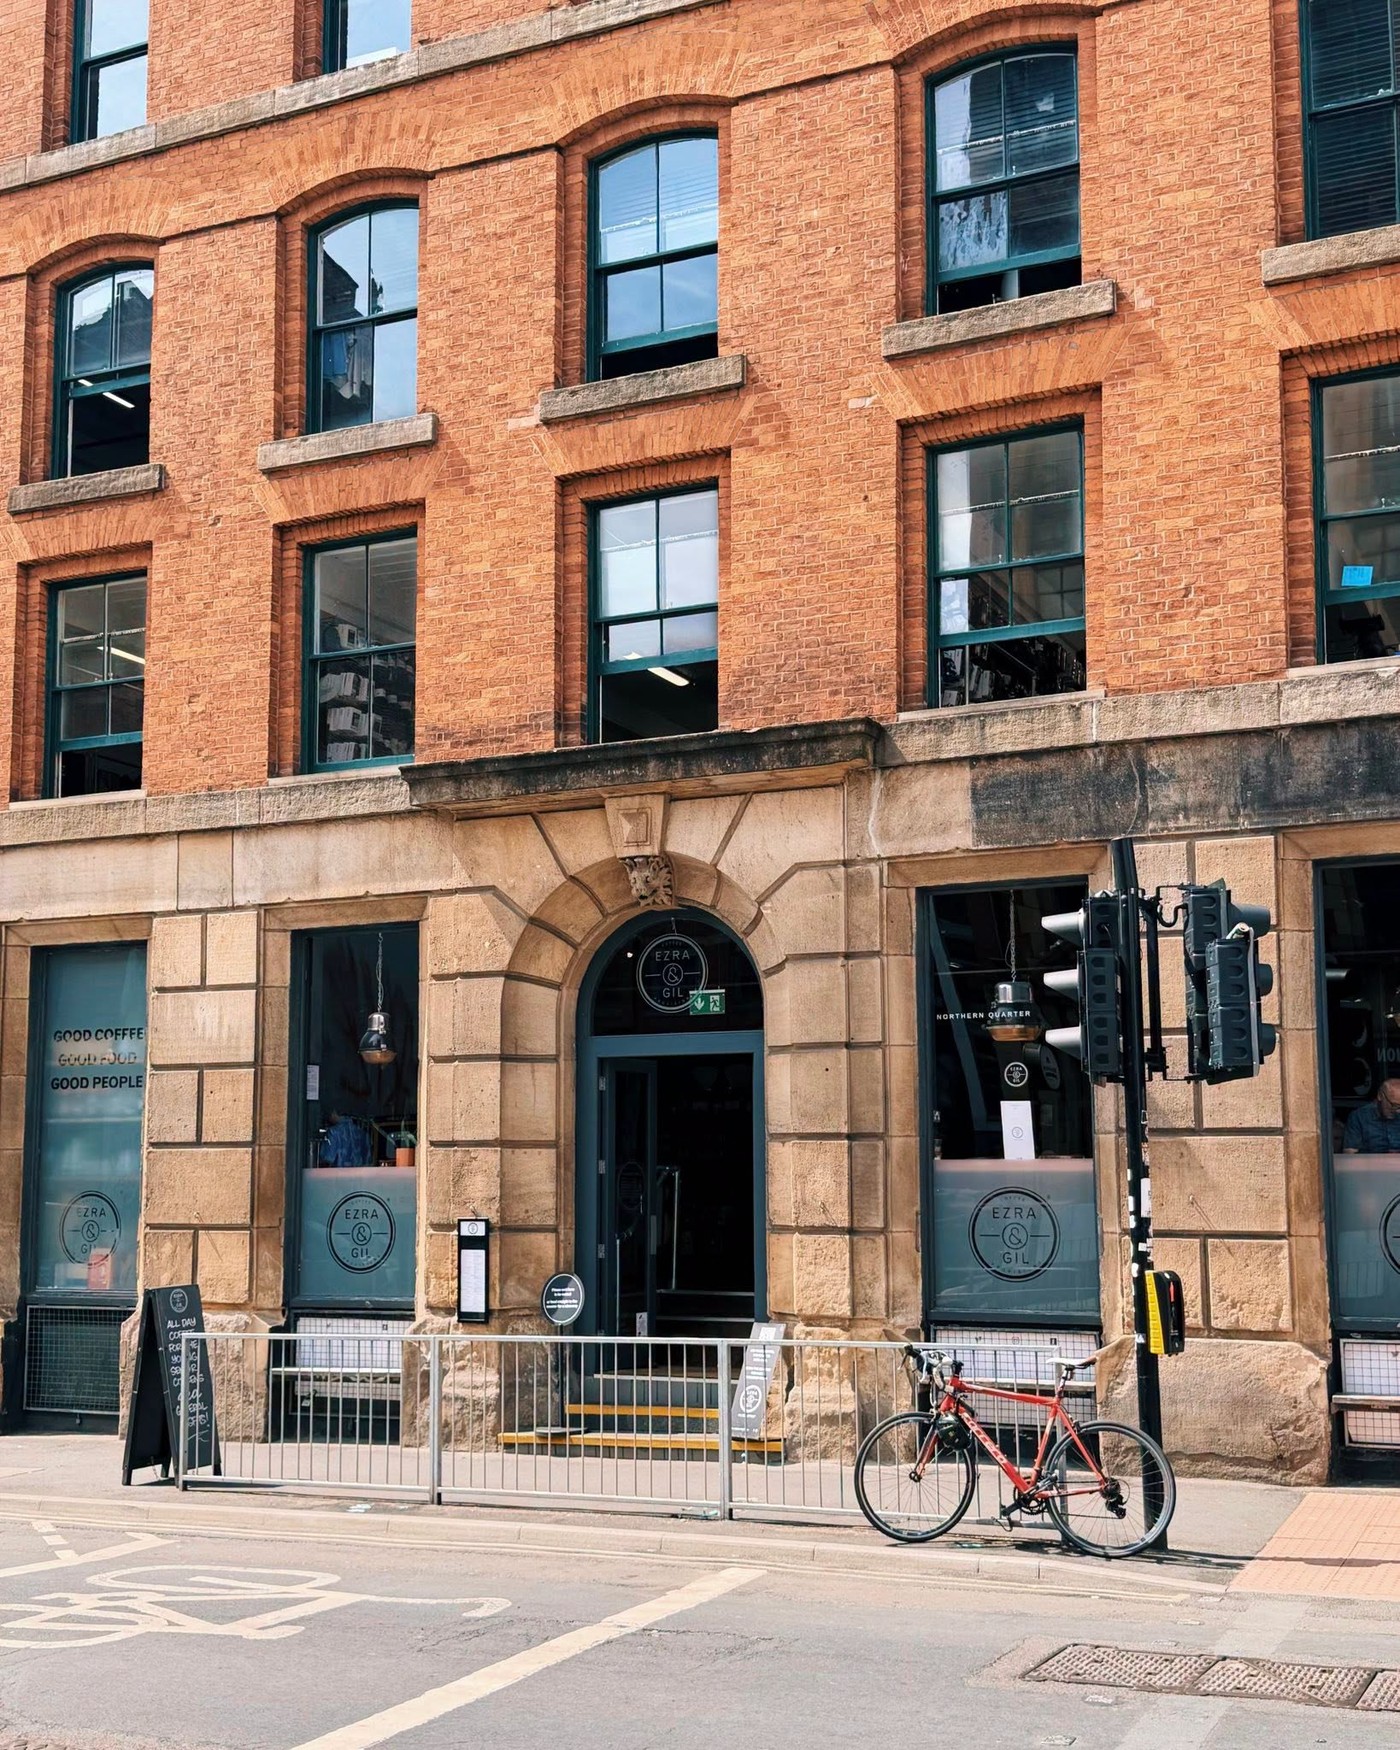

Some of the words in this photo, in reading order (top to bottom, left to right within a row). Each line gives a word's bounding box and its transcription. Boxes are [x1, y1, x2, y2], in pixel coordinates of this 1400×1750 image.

[655, 950, 690, 961] EZRA
[667, 966, 679, 982] &
[662, 988, 684, 998] GIL
[936, 1012, 985, 1020] NORTHERN
[988, 1010, 1031, 1019] QUARTER
[53, 1030, 92, 1043] GOOD
[94, 1027, 144, 1041] COFFEE
[58, 1052, 97, 1066] GOOD
[51, 1076, 89, 1089] GOOD
[92, 1075, 143, 1088] PEOPLE
[77, 1207, 106, 1217] EZRA
[345, 1208, 379, 1220] EZRA
[992, 1206, 1037, 1219] EZRA
[86, 1223, 95, 1239] &
[356, 1225, 367, 1242] &
[1008, 1226, 1023, 1245] &
[351, 1247, 370, 1258] GIL
[1002, 1251, 1029, 1264] GIL
[167, 1320, 180, 1328] ALL
[181, 1317, 196, 1327] DAY
